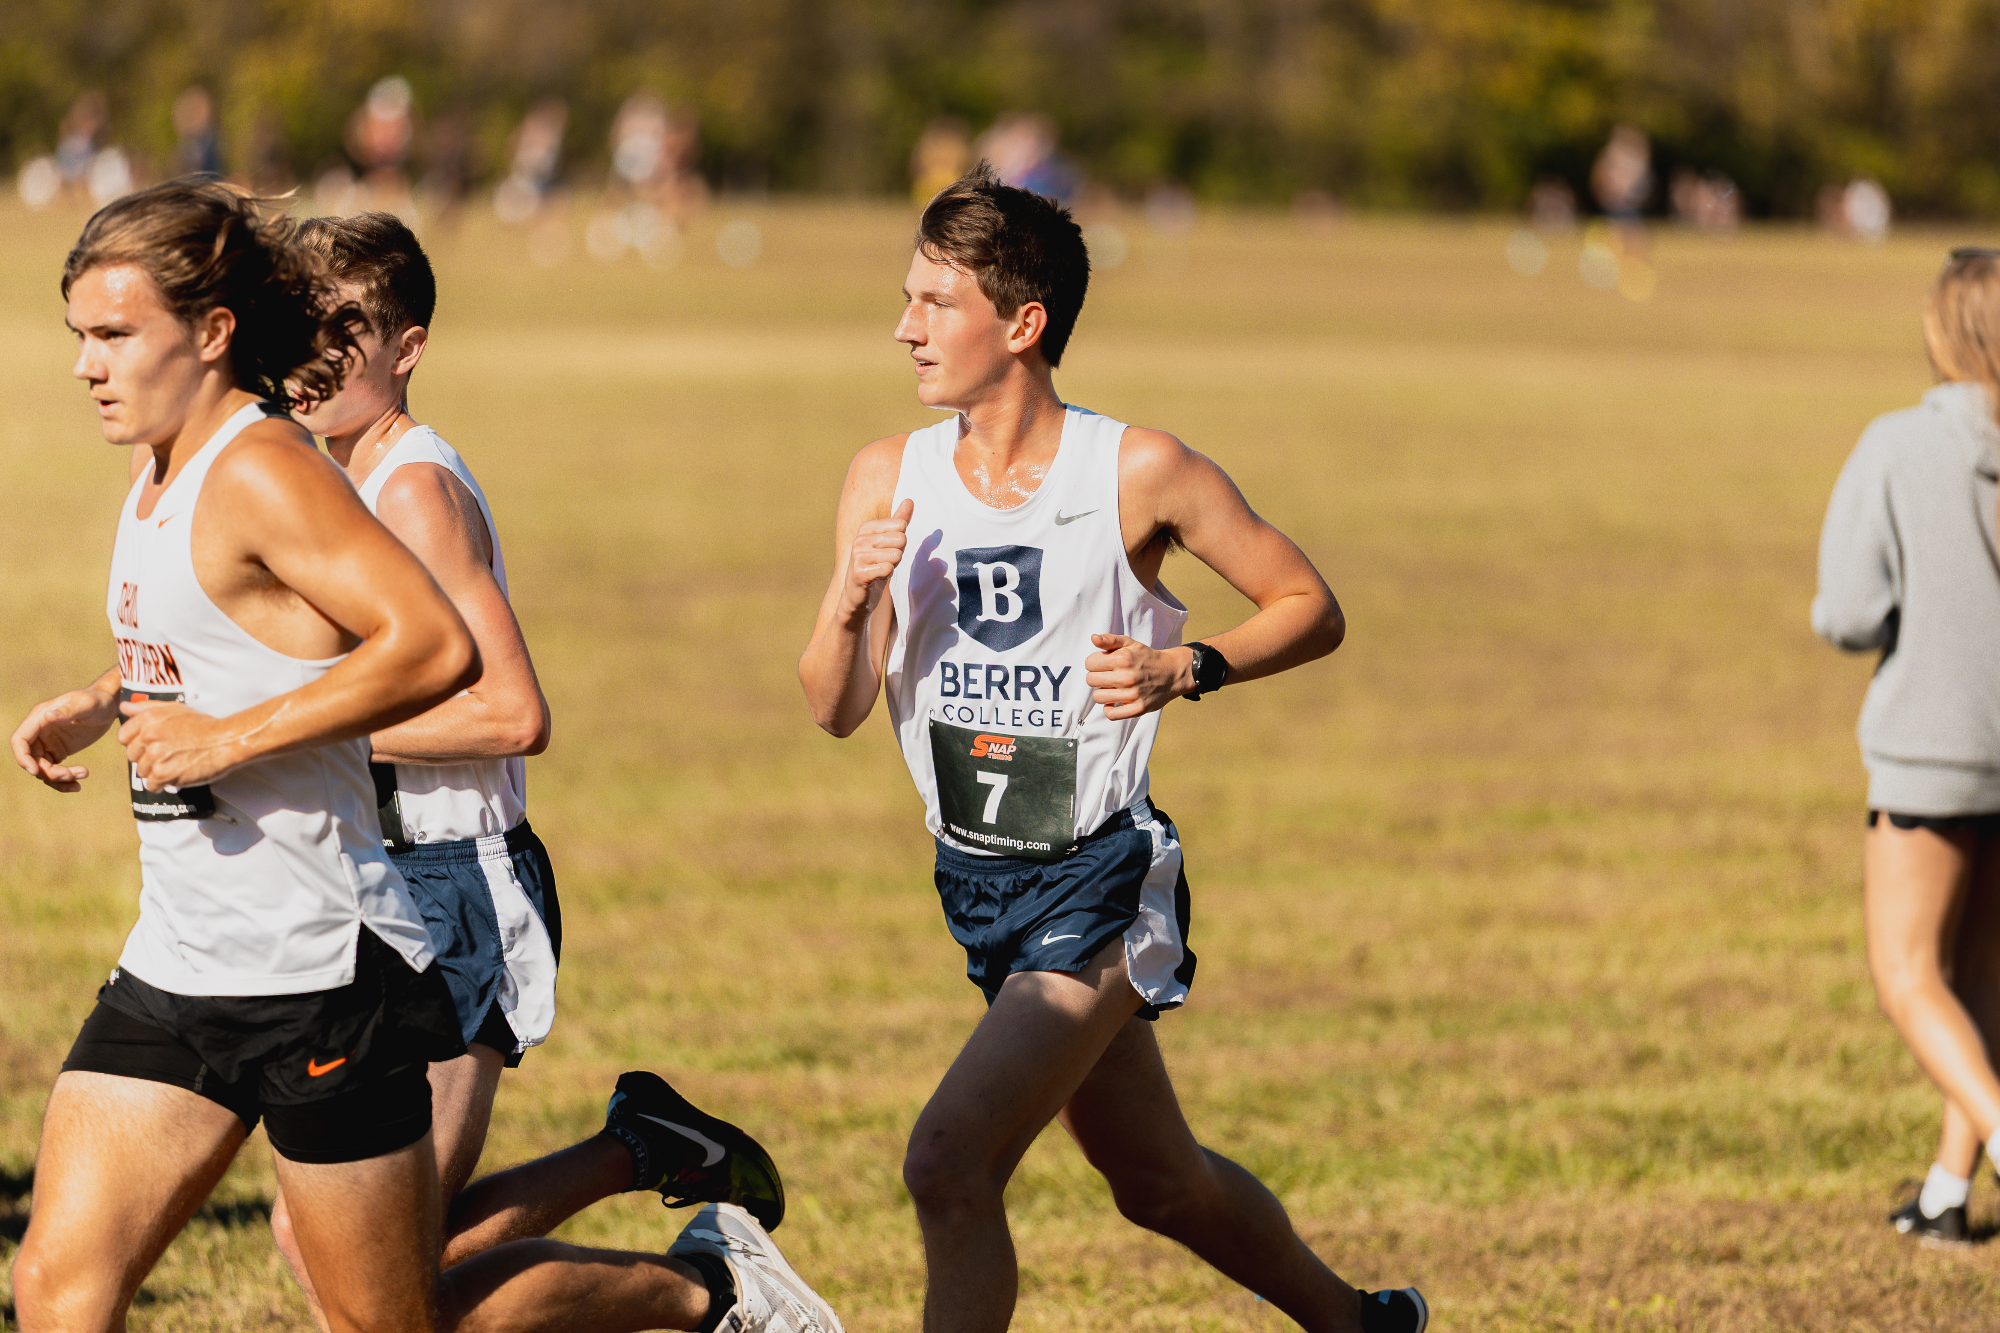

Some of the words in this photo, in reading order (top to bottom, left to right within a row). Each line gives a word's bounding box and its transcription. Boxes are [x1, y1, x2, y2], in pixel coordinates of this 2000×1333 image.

[972, 561, 1024, 622] B
[939, 661, 1072, 702] BERRY
[942, 703, 1064, 728] COLLEGE
[970, 734, 1017, 757] SNAP
[987, 752, 1013, 762] TIMING
[976, 770, 1009, 825] 7
[949, 822, 1051, 852] www.snaptiming.com
